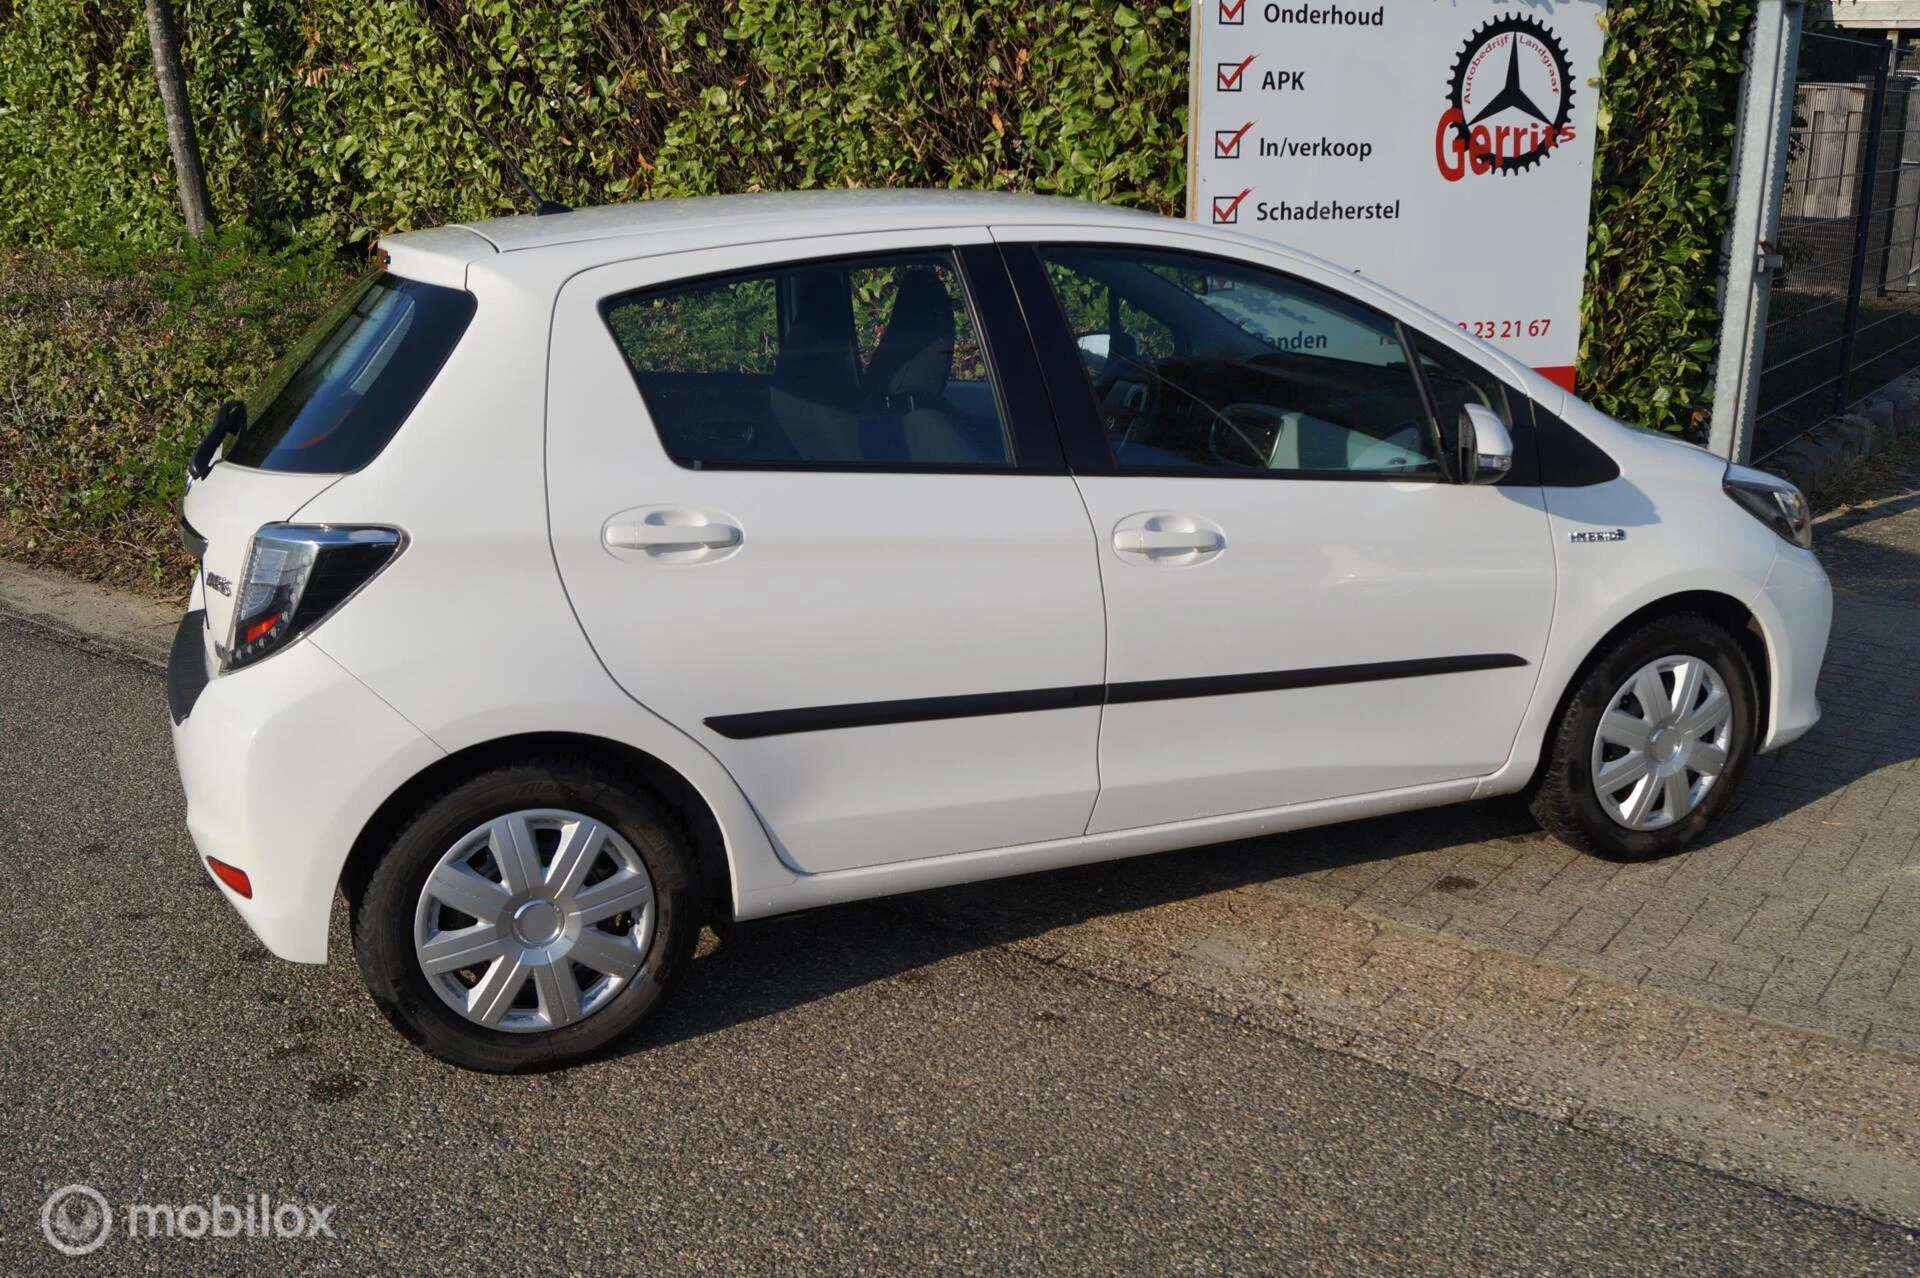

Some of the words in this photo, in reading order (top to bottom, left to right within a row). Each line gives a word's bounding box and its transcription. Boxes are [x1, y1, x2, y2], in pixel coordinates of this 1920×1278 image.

[1264, 3, 1384, 26] Onderhoud
[1261, 71, 1305, 91] APK
[1463, 34, 1510, 105] Autobedrijf
[1518, 34, 1561, 96] Landgraaf
[1259, 137, 1373, 161] In/verkoop
[1435, 106, 1577, 182] Gerrits
[1256, 200, 1400, 222] Schadeherstel
[1473, 320, 1496, 339] 23
[1500, 319, 1522, 338] 21
[1528, 318, 1552, 337] 67
